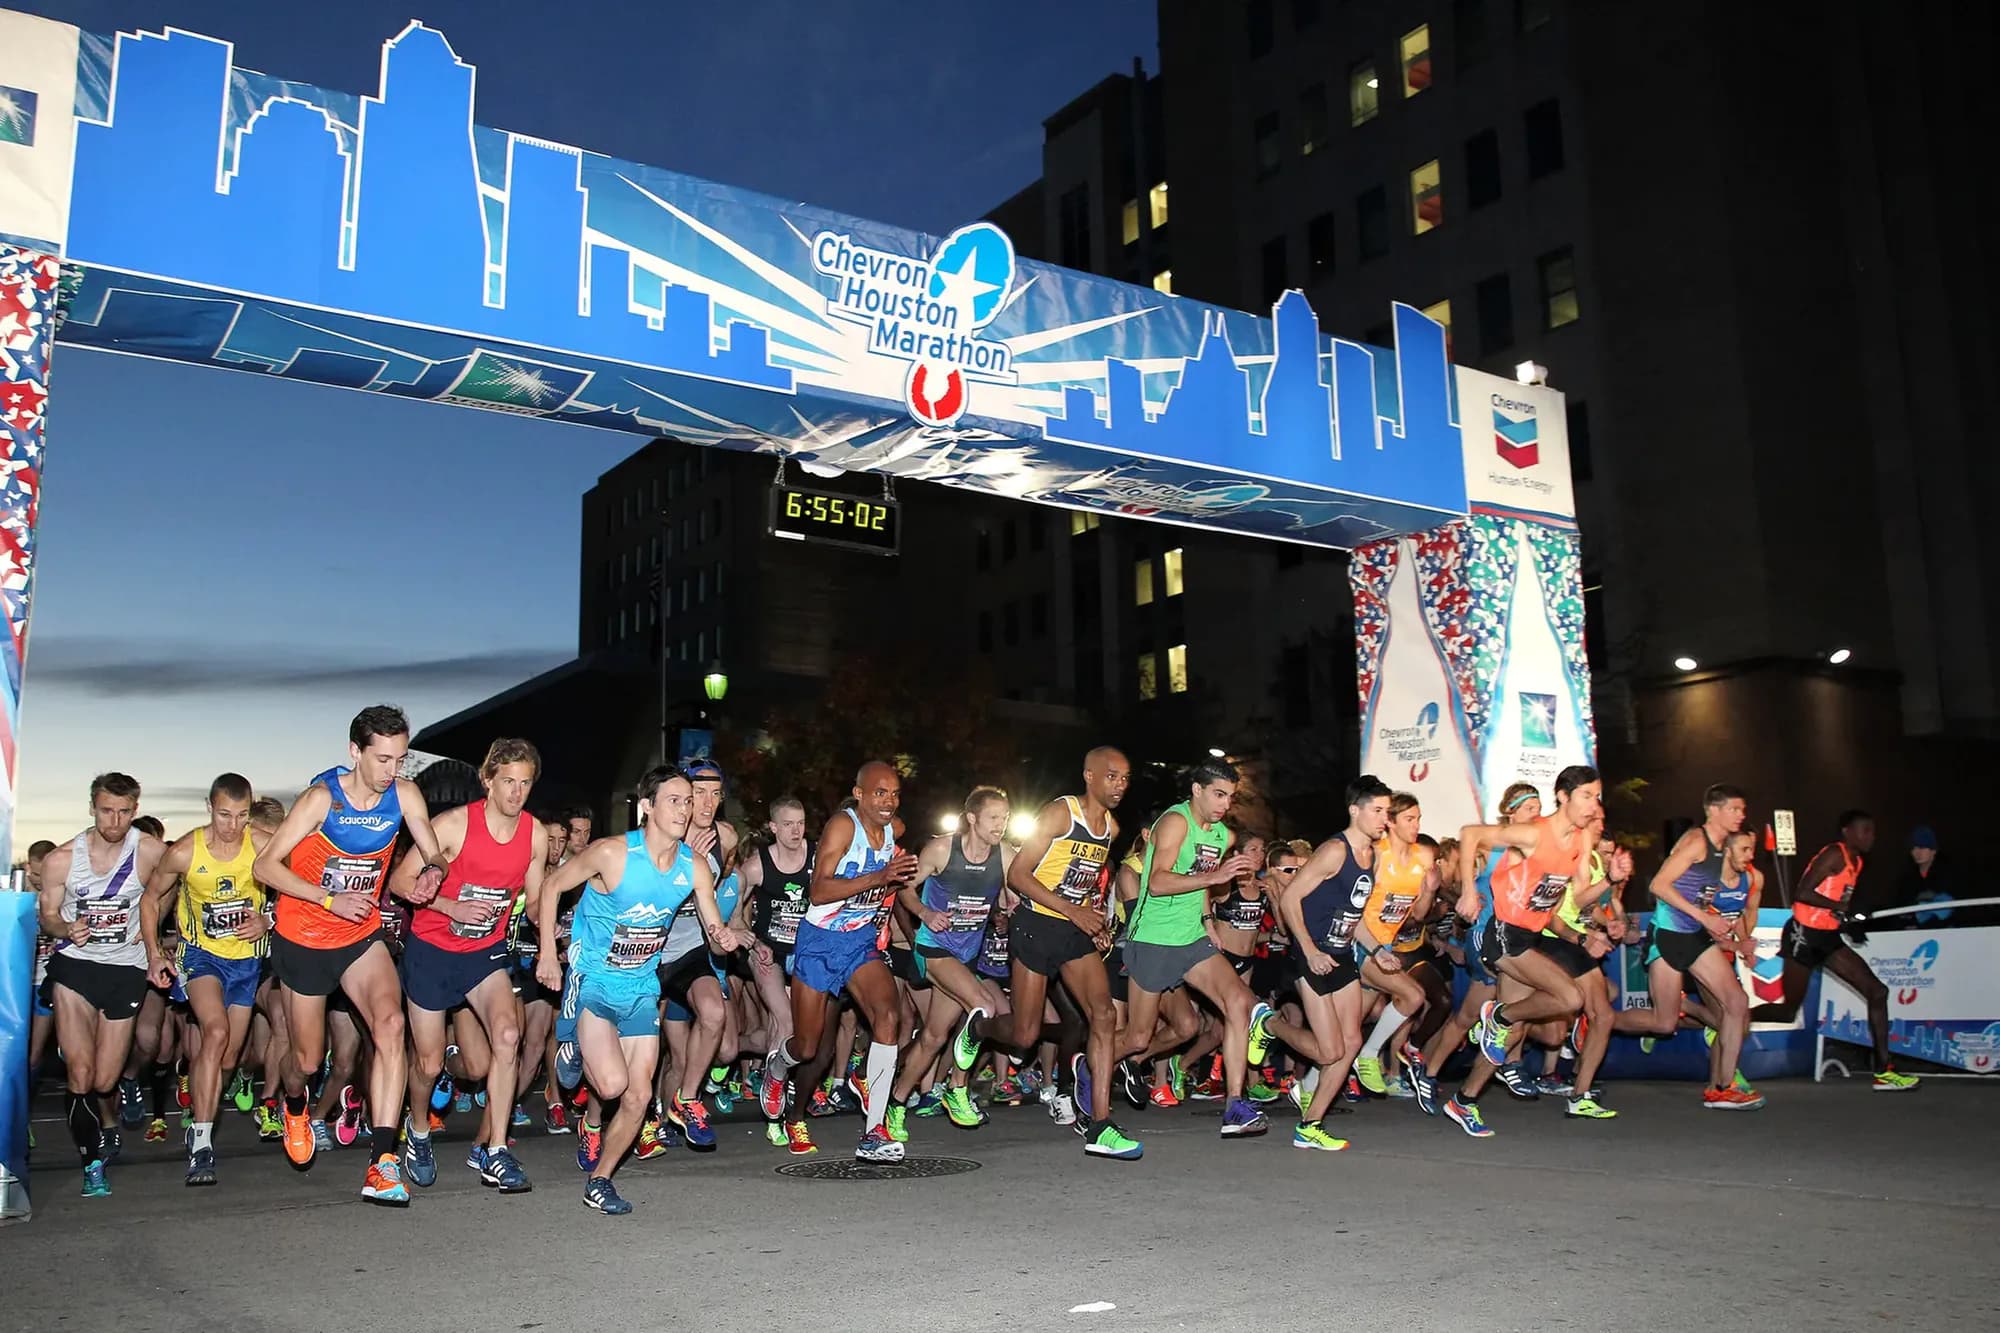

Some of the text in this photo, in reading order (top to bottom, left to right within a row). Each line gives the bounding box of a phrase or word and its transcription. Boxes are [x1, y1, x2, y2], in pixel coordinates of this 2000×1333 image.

[818, 237, 927, 288] Chevron
[844, 277, 958, 329] Houston
[876, 318, 1006, 372] Marathon
[1491, 393, 1537, 415] Chevron
[1380, 728, 1416, 739] Chevron
[1388, 738, 1424, 750] Houston
[1398, 748, 1440, 761] Marathon
[338, 815, 382, 826] saucony
[1071, 842, 1088, 858] U.S.
[321, 872, 378, 891] B. YORK
[105, 913, 127, 925] SEE
[1887, 976, 1935, 987] Marathon
